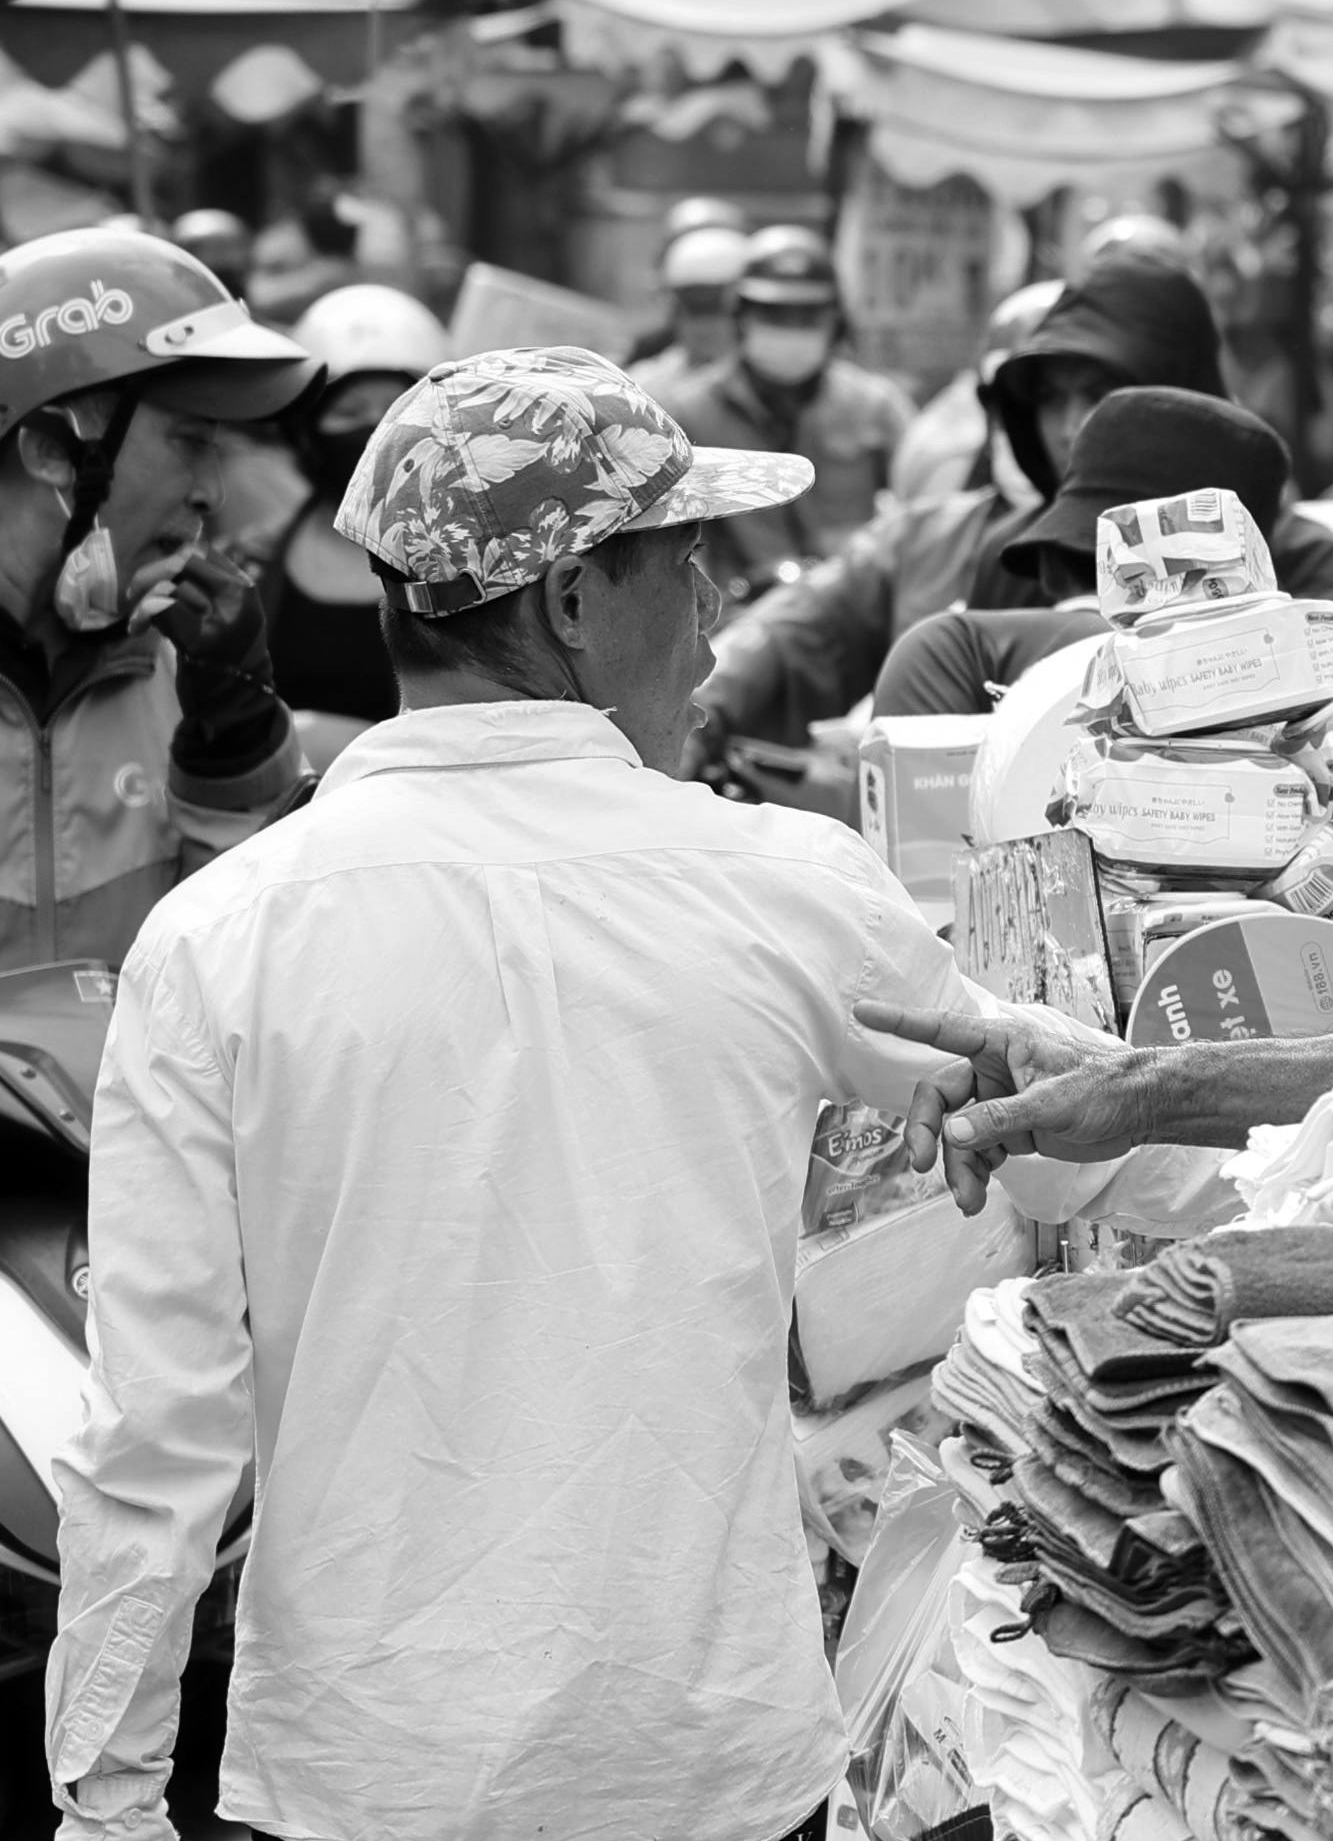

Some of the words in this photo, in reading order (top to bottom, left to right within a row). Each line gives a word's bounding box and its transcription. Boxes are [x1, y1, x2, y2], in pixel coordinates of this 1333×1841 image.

[0, 278, 134, 360] Grab
[1158, 675, 1188, 694] wipes
[1189, 669, 1216, 684] SAFETY
[1217, 664, 1239, 677] BABY
[1239, 657, 1263, 671] WIPES
[1108, 803, 1138, 820] wipes
[1141, 806, 1168, 819] SAFETY
[1169, 810, 1192, 822] BABY
[1192, 812, 1216, 823] WIPES
[1212, 968, 1240, 1010] xe
[1158, 984, 1192, 1041] anh
[827, 1127, 883, 1158] E'mos
